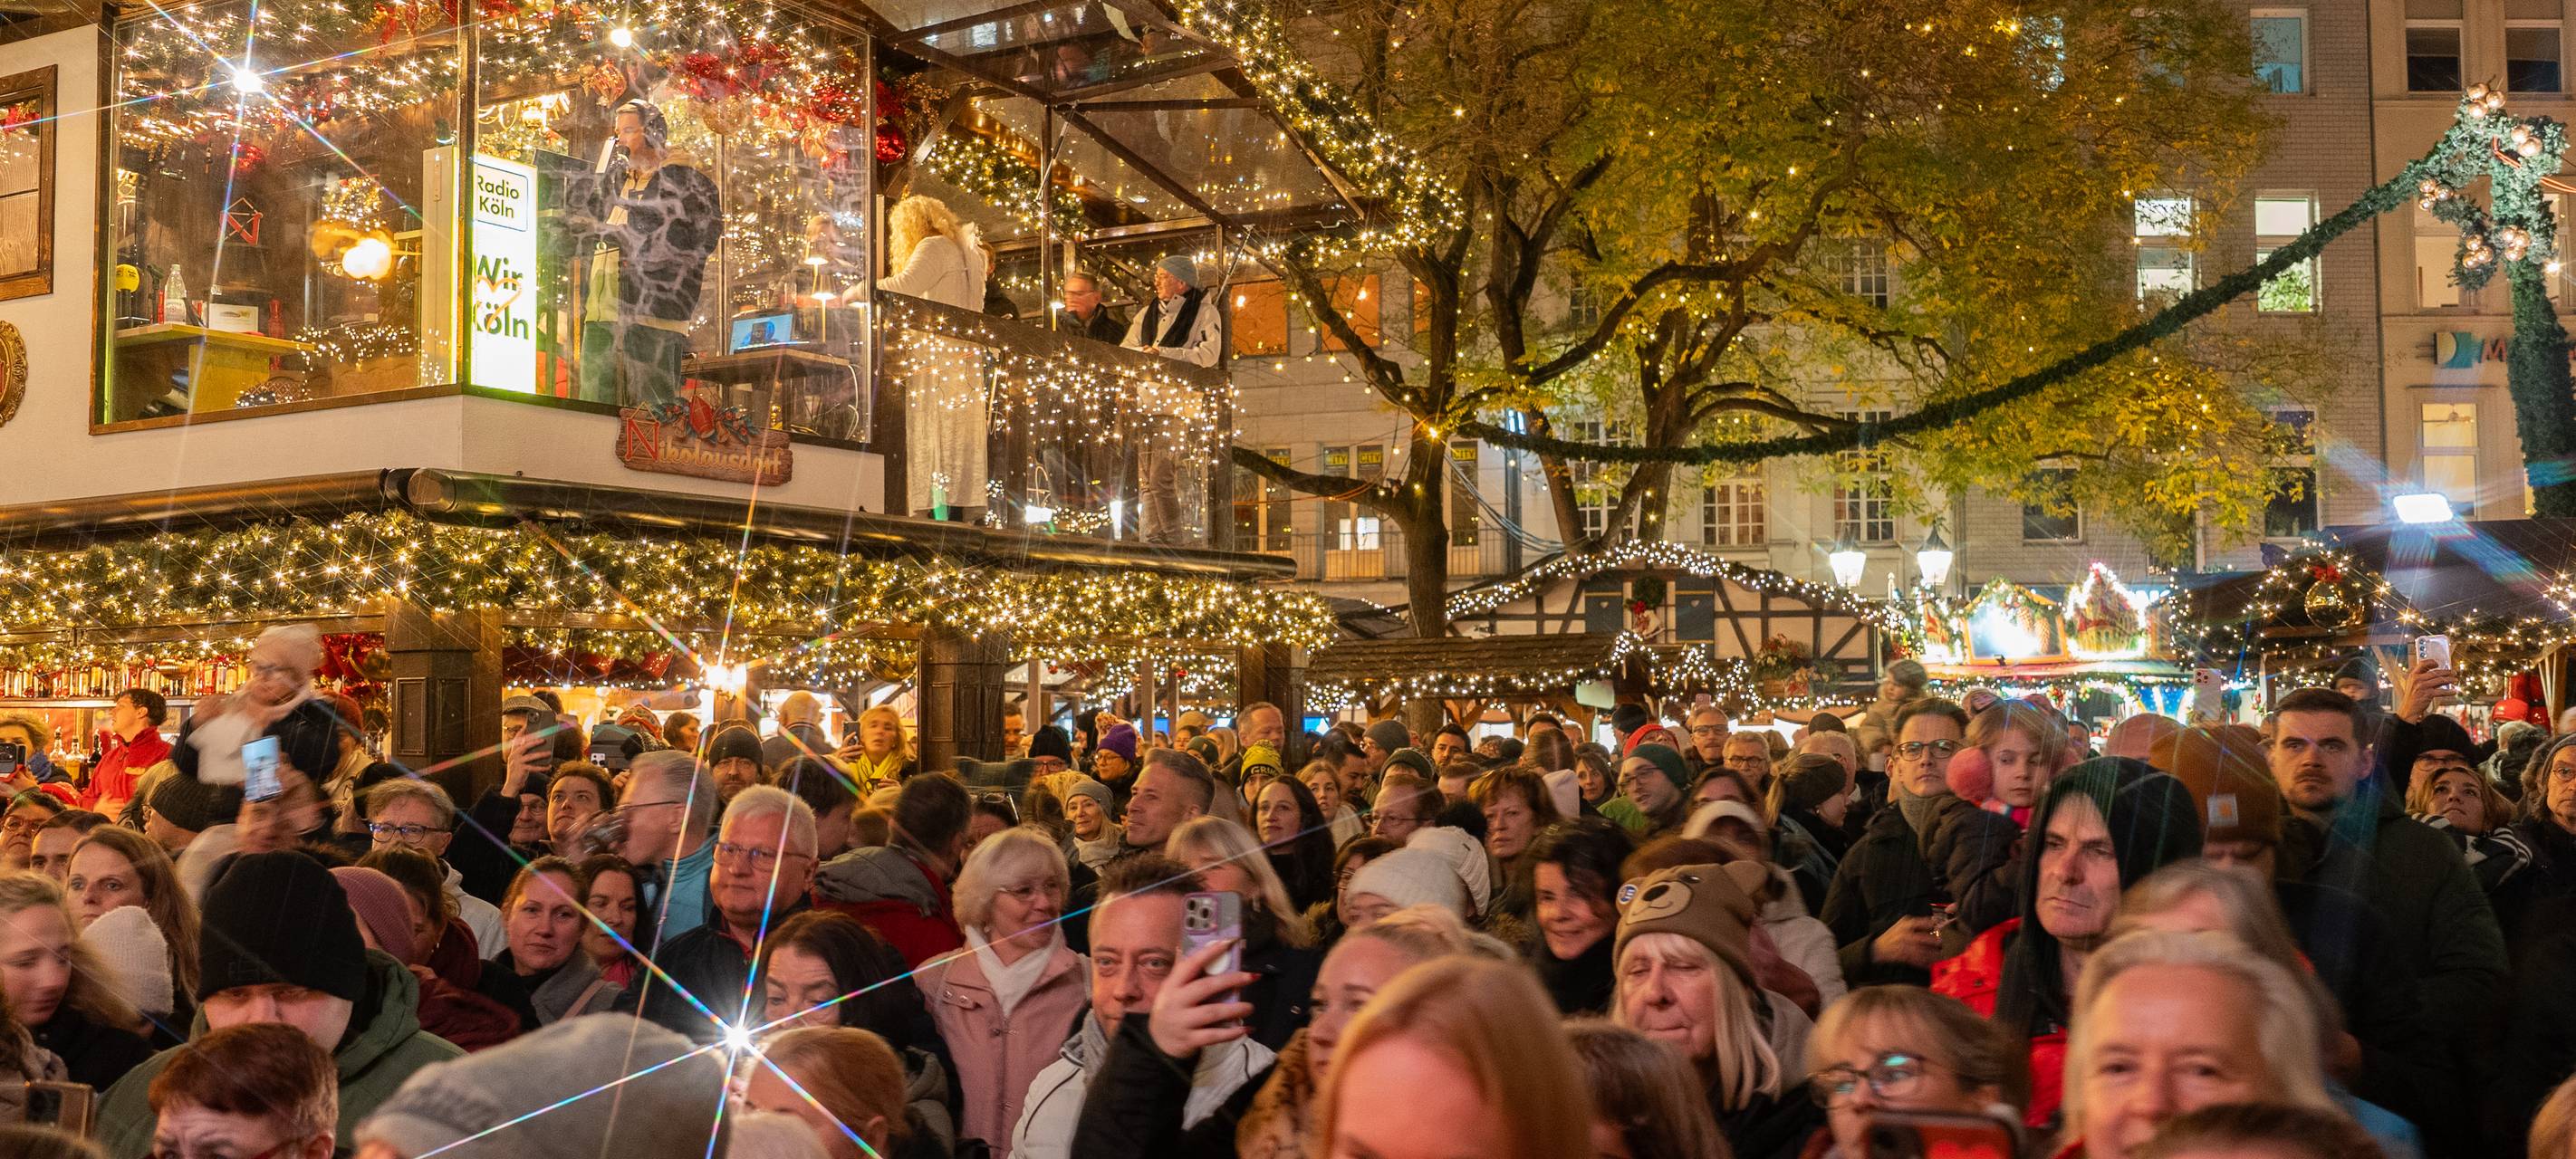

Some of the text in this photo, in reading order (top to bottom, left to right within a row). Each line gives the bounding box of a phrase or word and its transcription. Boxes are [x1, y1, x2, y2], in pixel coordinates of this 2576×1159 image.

[477, 176, 520, 200] Radio
[480, 196, 514, 219] Köln
[476, 254, 523, 292] Wir
[624, 417, 784, 475] Nikolausdorf
